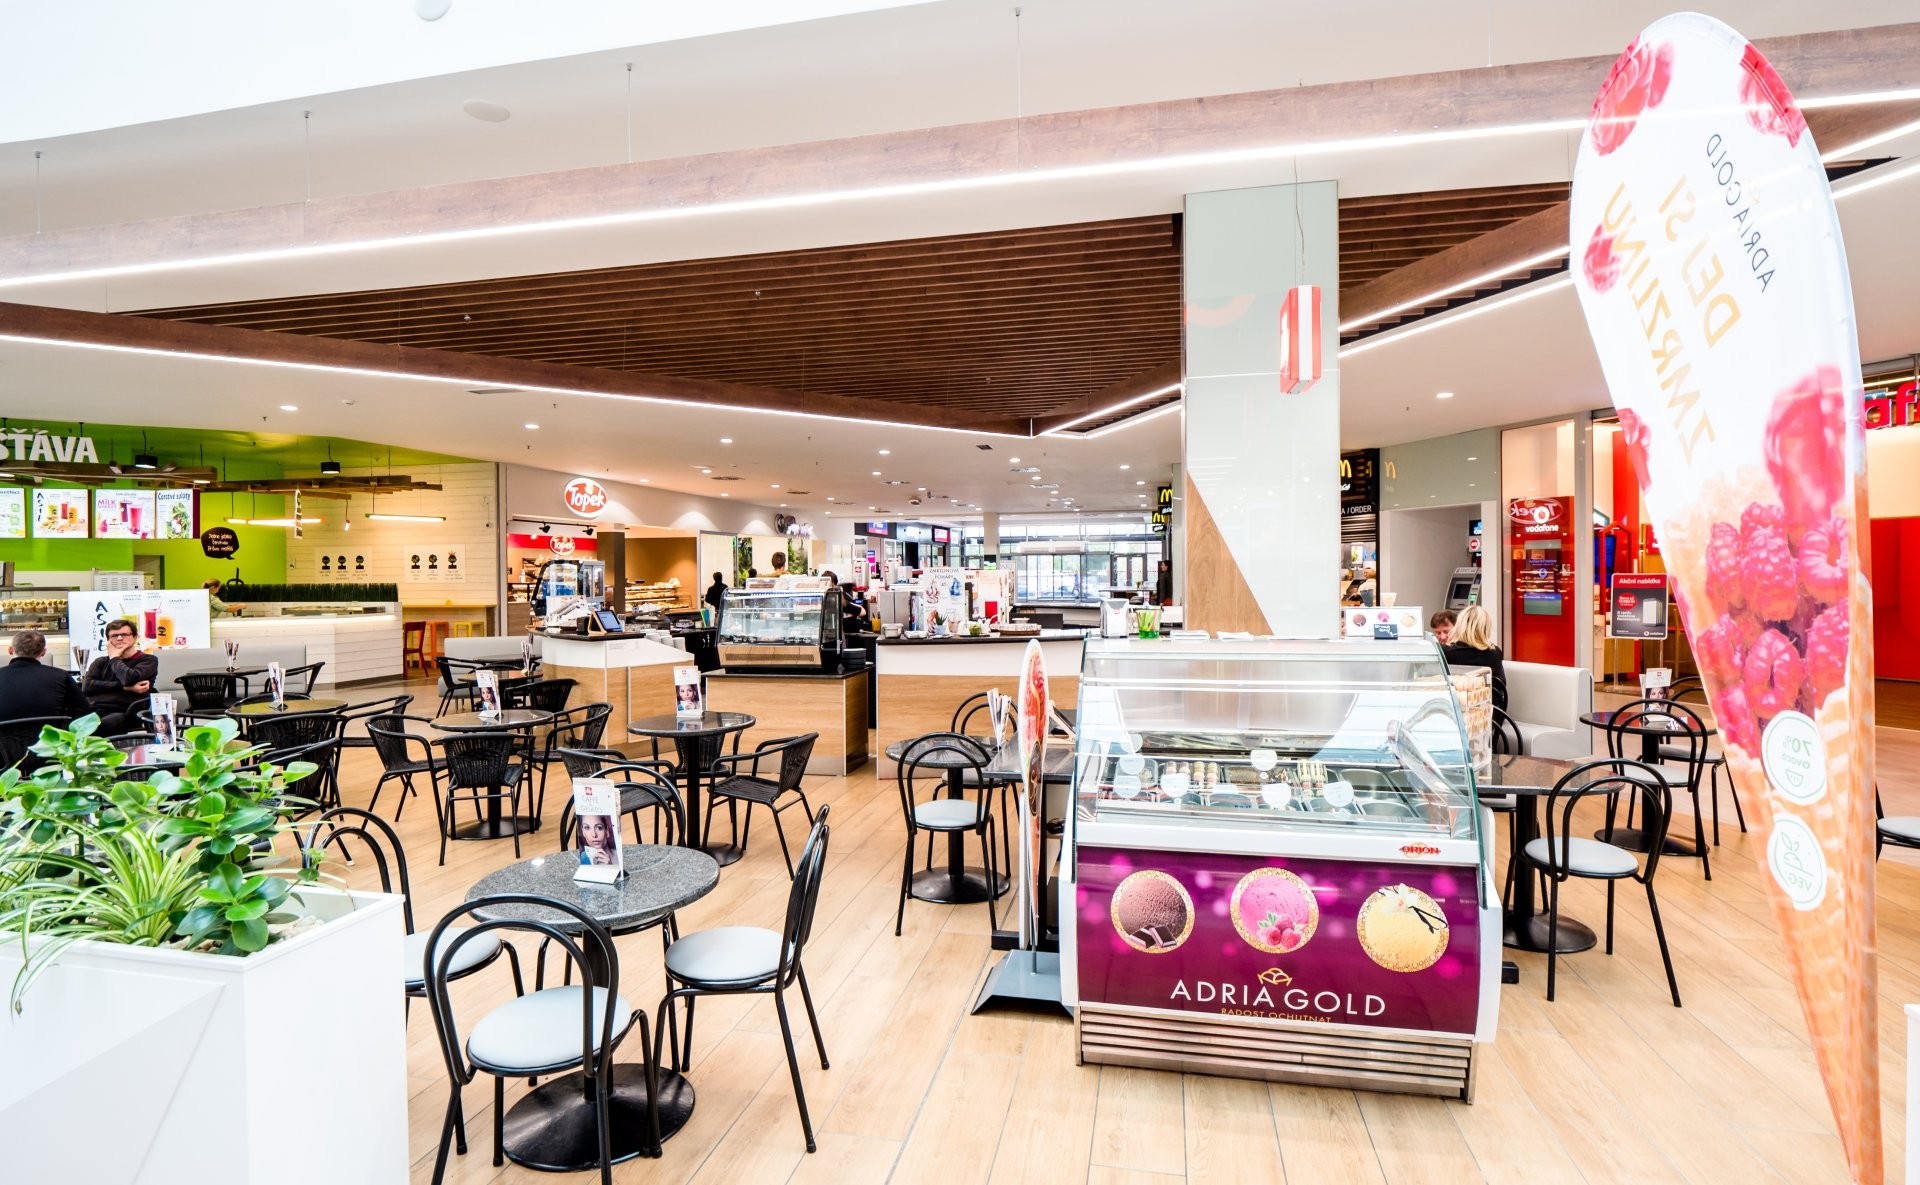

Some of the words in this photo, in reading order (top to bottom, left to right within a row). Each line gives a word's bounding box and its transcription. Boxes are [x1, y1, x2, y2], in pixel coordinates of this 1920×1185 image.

[568, 485, 605, 512] Topek
[1350, 504, 1372, 514] ORDER
[1525, 524, 1559, 533] vodafone
[553, 538, 574, 552] Topek
[1401, 845, 1440, 855] ORION
[1170, 978, 1275, 1008] ADRIA
[1283, 988, 1386, 1017] GOLD
[1221, 1007, 1264, 1018] RADOST
[1268, 1012, 1332, 1023] OCHUTNAT
